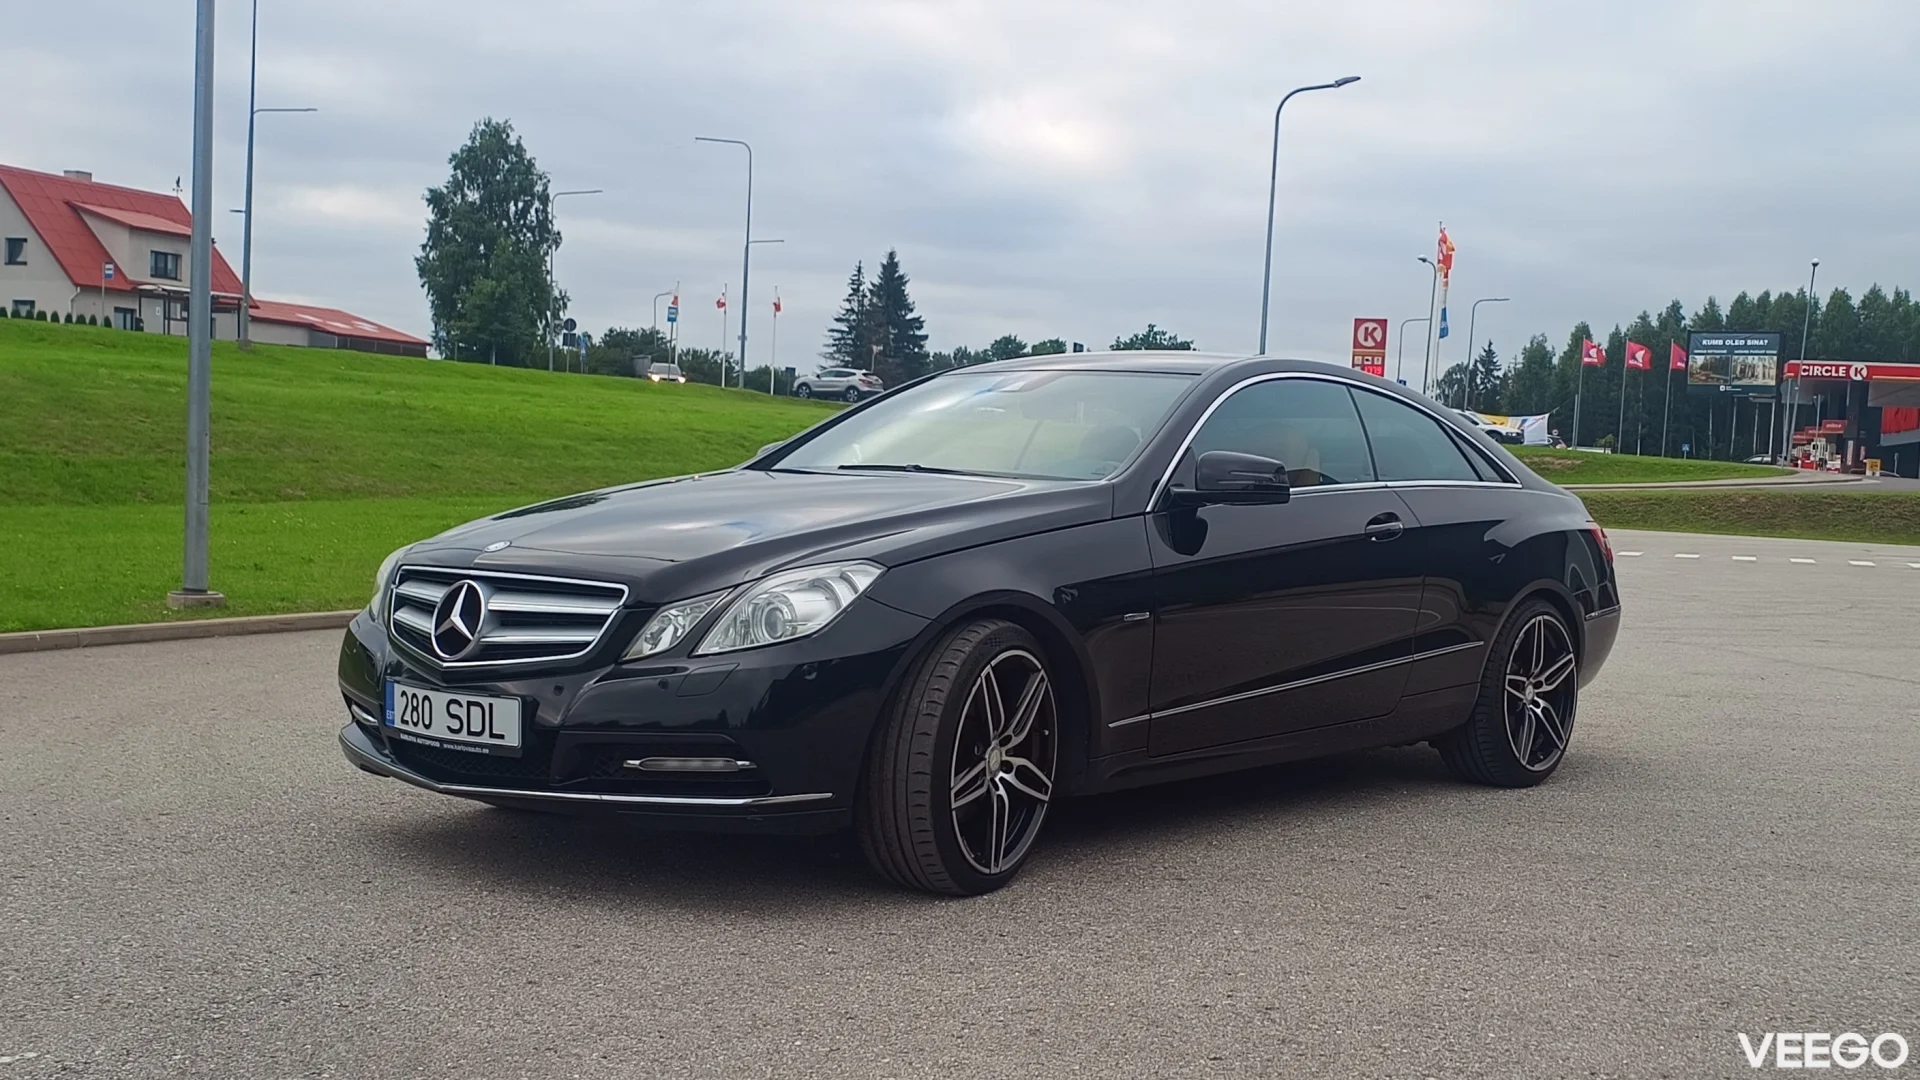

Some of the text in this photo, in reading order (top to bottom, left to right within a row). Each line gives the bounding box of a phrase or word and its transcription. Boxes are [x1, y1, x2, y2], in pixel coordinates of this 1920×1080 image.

[1363, 326, 1379, 344] K
[1801, 365, 1846, 377] CIRCLE
[386, 709, 395, 720] EST
[400, 689, 505, 740] 280 SDL
